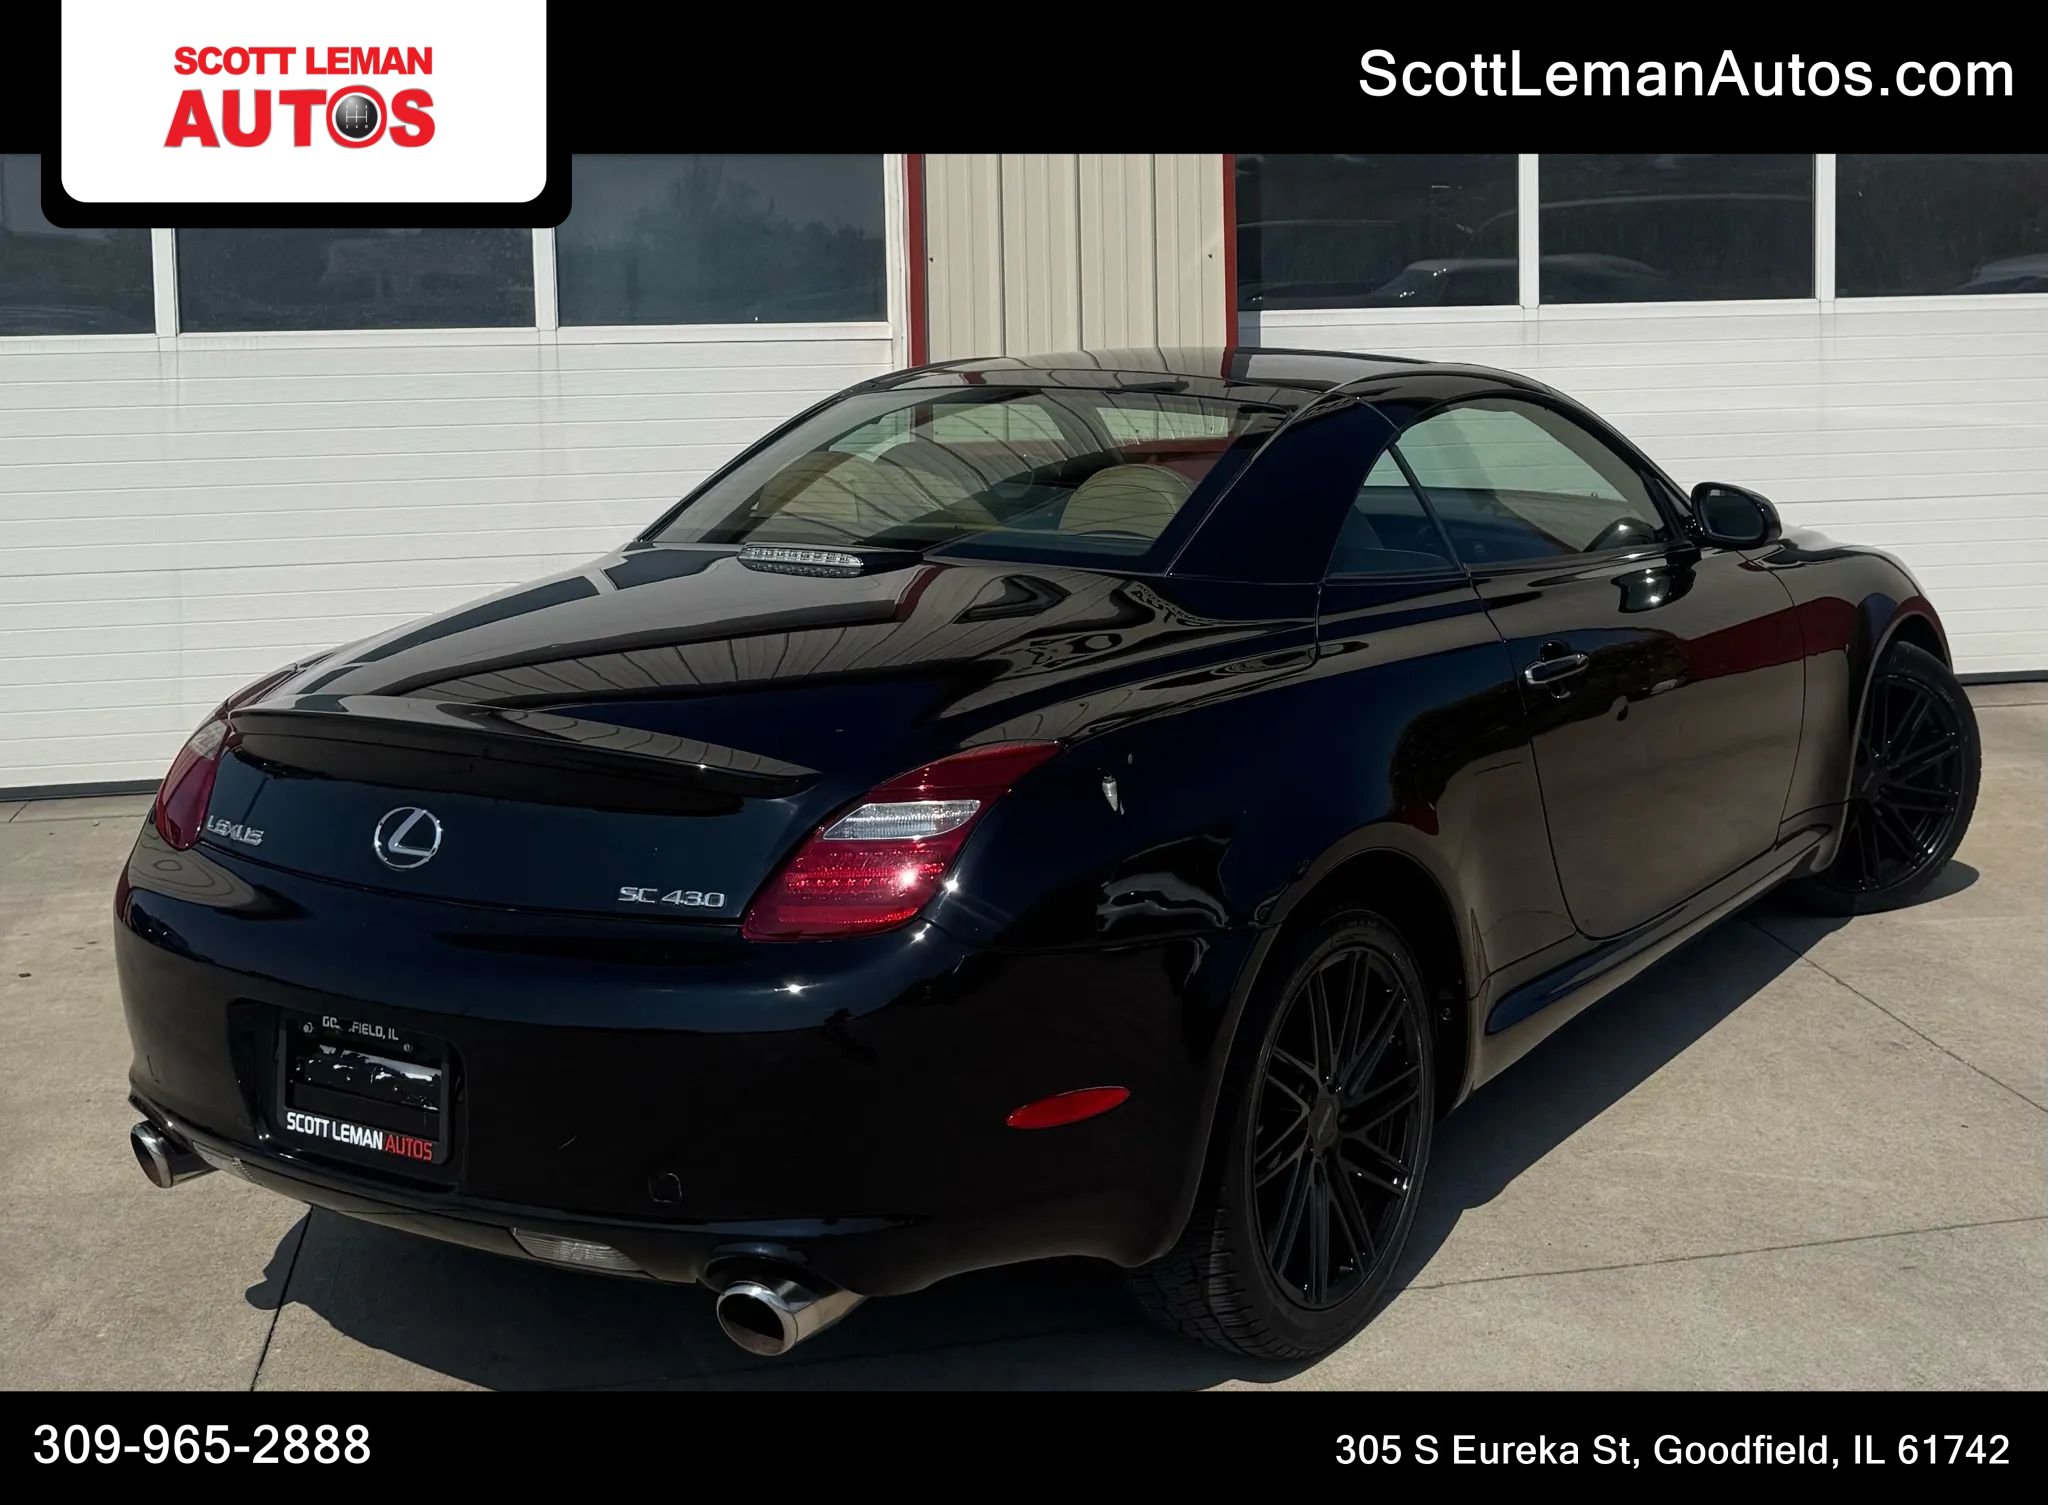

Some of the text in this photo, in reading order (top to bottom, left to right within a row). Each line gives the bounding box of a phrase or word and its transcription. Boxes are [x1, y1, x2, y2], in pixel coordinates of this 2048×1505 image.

[207, 814, 264, 846] LEXUS
[618, 886, 726, 909] SC 430
[322, 1015, 400, 1041] GOFIELD, IL
[287, 1112, 433, 1161] SCOTT LEMAN AUTOS
